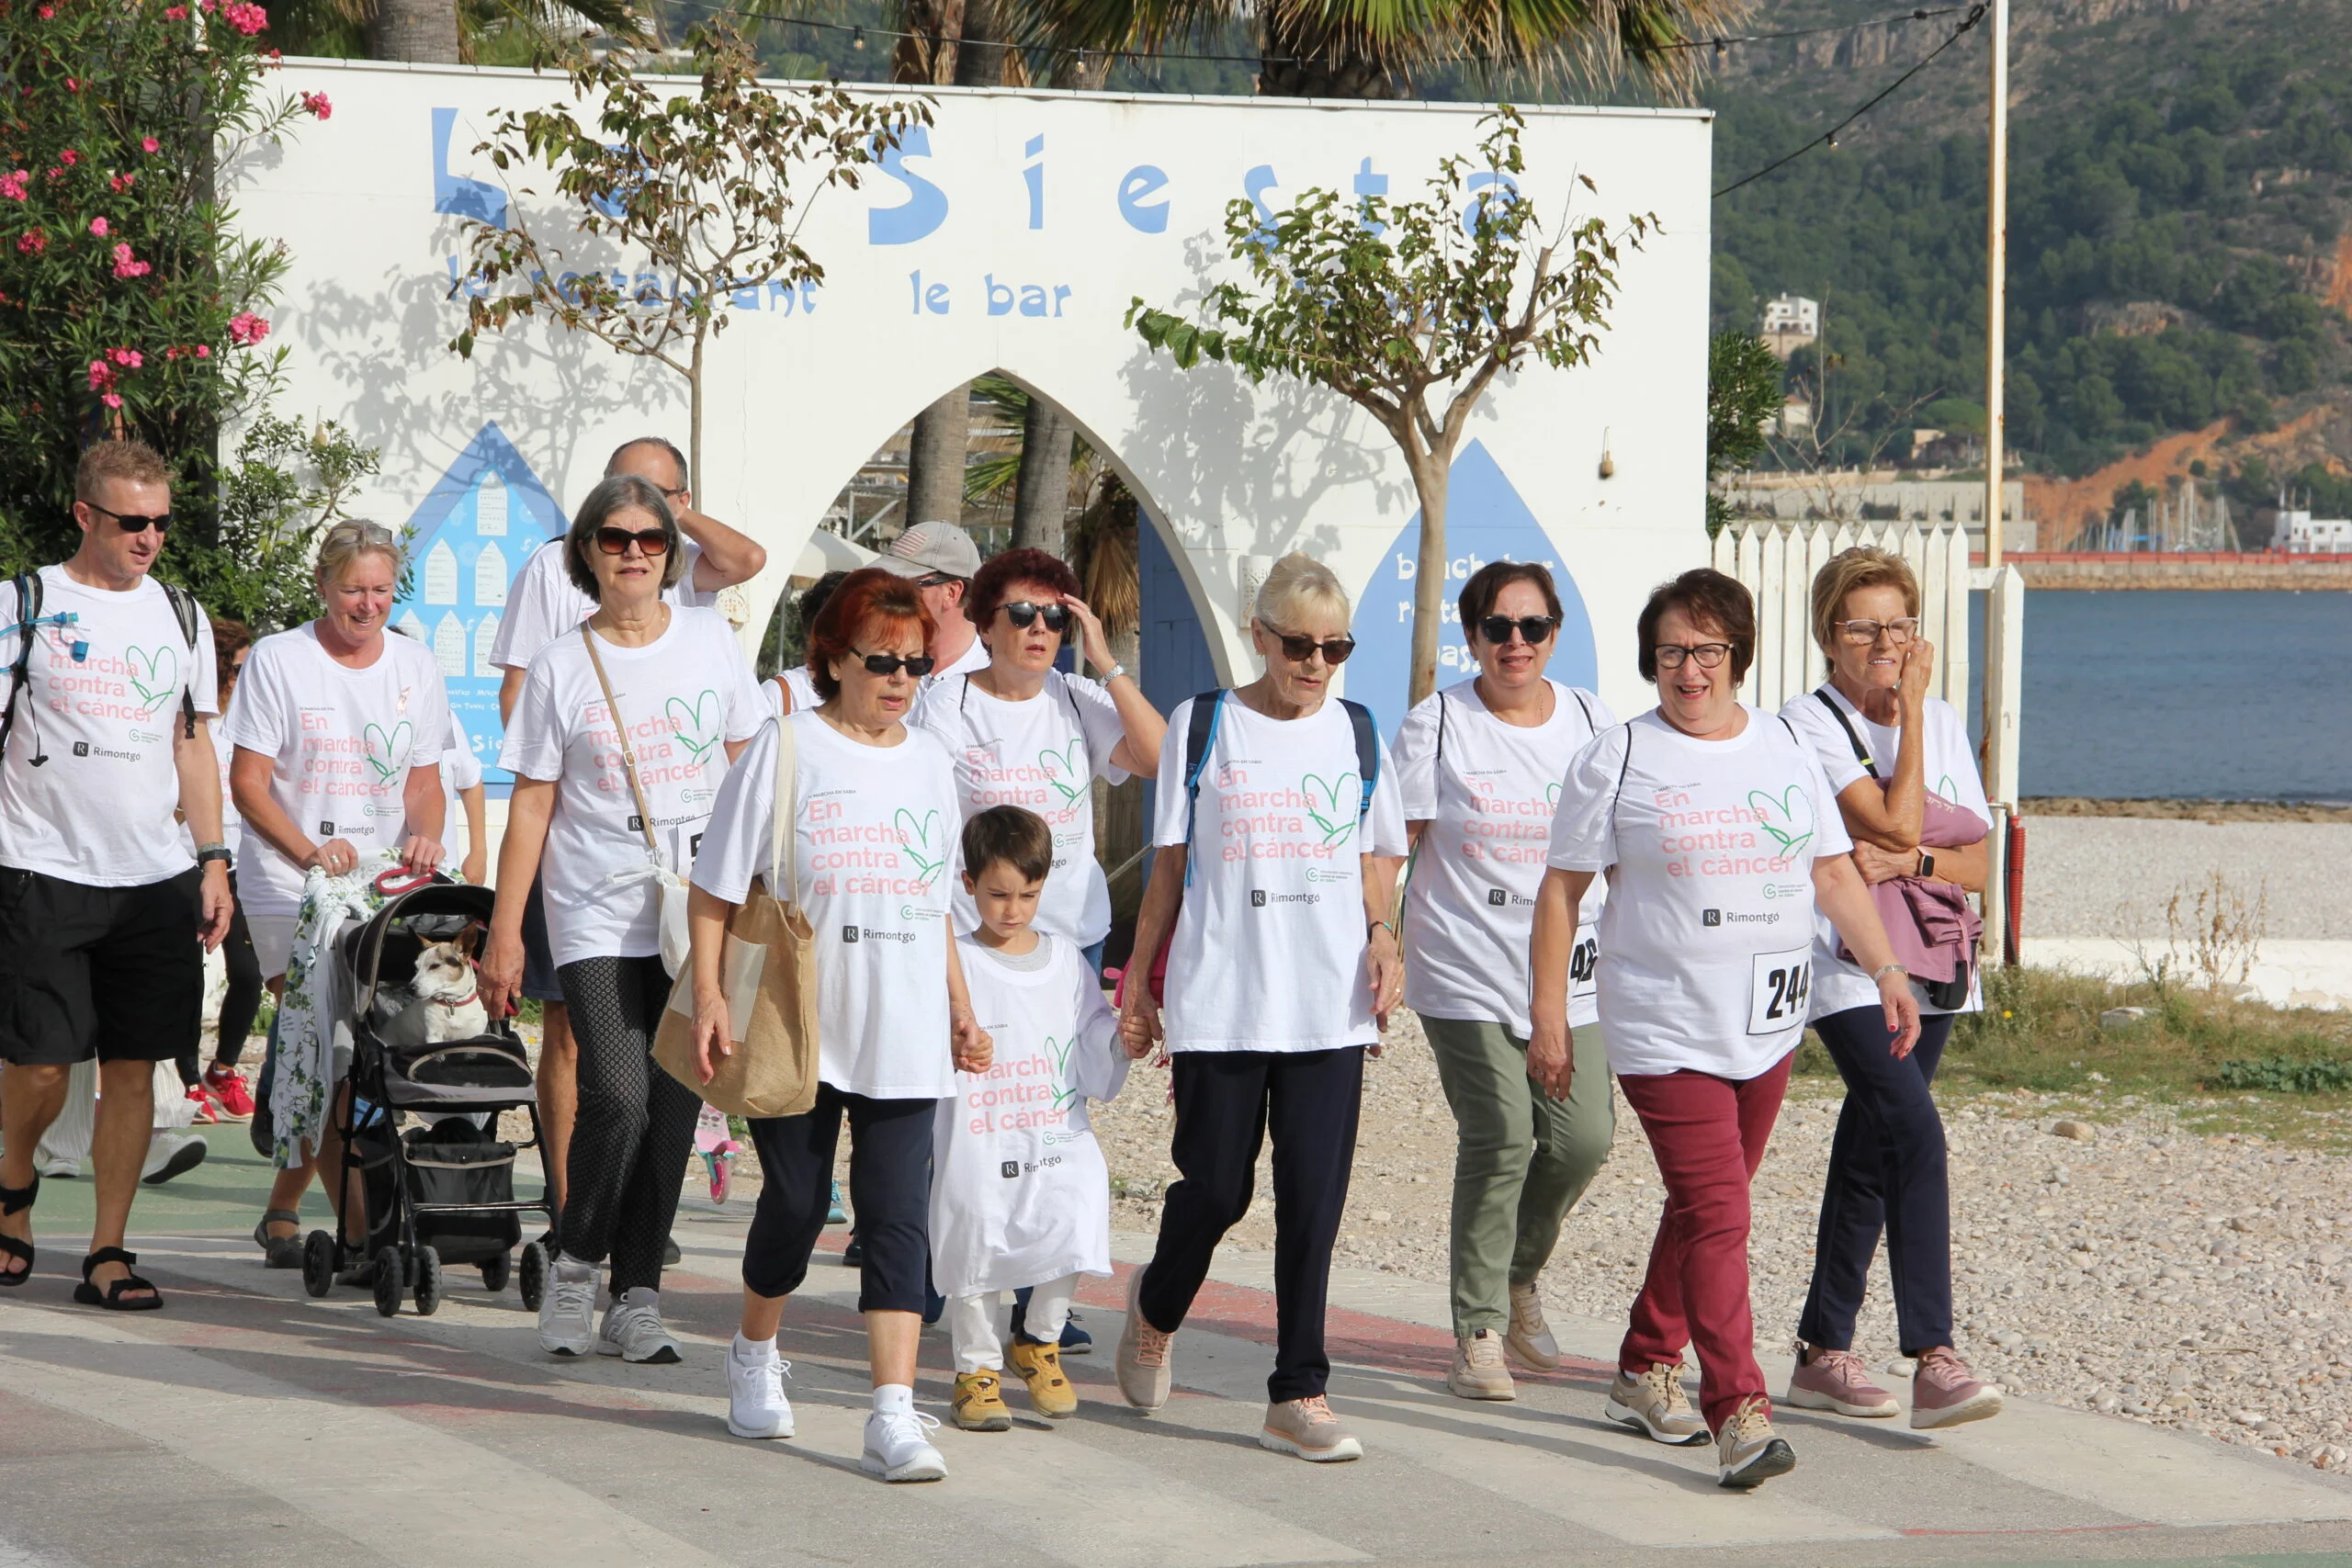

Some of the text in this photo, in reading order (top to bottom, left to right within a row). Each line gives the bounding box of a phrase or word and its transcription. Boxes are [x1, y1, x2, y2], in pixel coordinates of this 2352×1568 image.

[867, 124, 1521, 261] Siesta
[447, 254, 489, 301] le
[909, 269, 1073, 318] le bar
[50, 653, 139, 677] marcha
[49, 675, 125, 697] contra
[50, 695, 153, 722] el cáncer
[301, 713, 328, 731] En
[302, 736, 376, 755] marcha
[594, 742, 673, 768] cotra
[305, 756, 363, 775] contra
[967, 750, 996, 765] En
[596, 772, 619, 793] el
[970, 763, 1057, 783] marcha
[1218, 769, 1248, 790] En
[300, 778, 319, 795] el
[970, 785, 1047, 806] contra
[1464, 776, 1494, 795] En
[809, 799, 842, 822] En
[1218, 787, 1317, 814] marcha
[1654, 791, 1690, 808] En
[1221, 812, 1304, 837] contra
[1464, 818, 1547, 840] contra
[1658, 805, 1770, 830] marcha
[810, 821, 911, 846] marcha
[1661, 829, 1757, 854] contra
[810, 847, 899, 871] contra
[1222, 837, 1337, 863] el cáncer
[1462, 840, 1485, 861] el
[1666, 853, 1795, 878] el cáncer
[814, 872, 931, 897] el cáncer
[1727, 912, 1780, 925] Rimontgó
[1766, 961, 1809, 1020] 244
[967, 1082, 1052, 1109] contra
[969, 1111, 995, 1134] el
